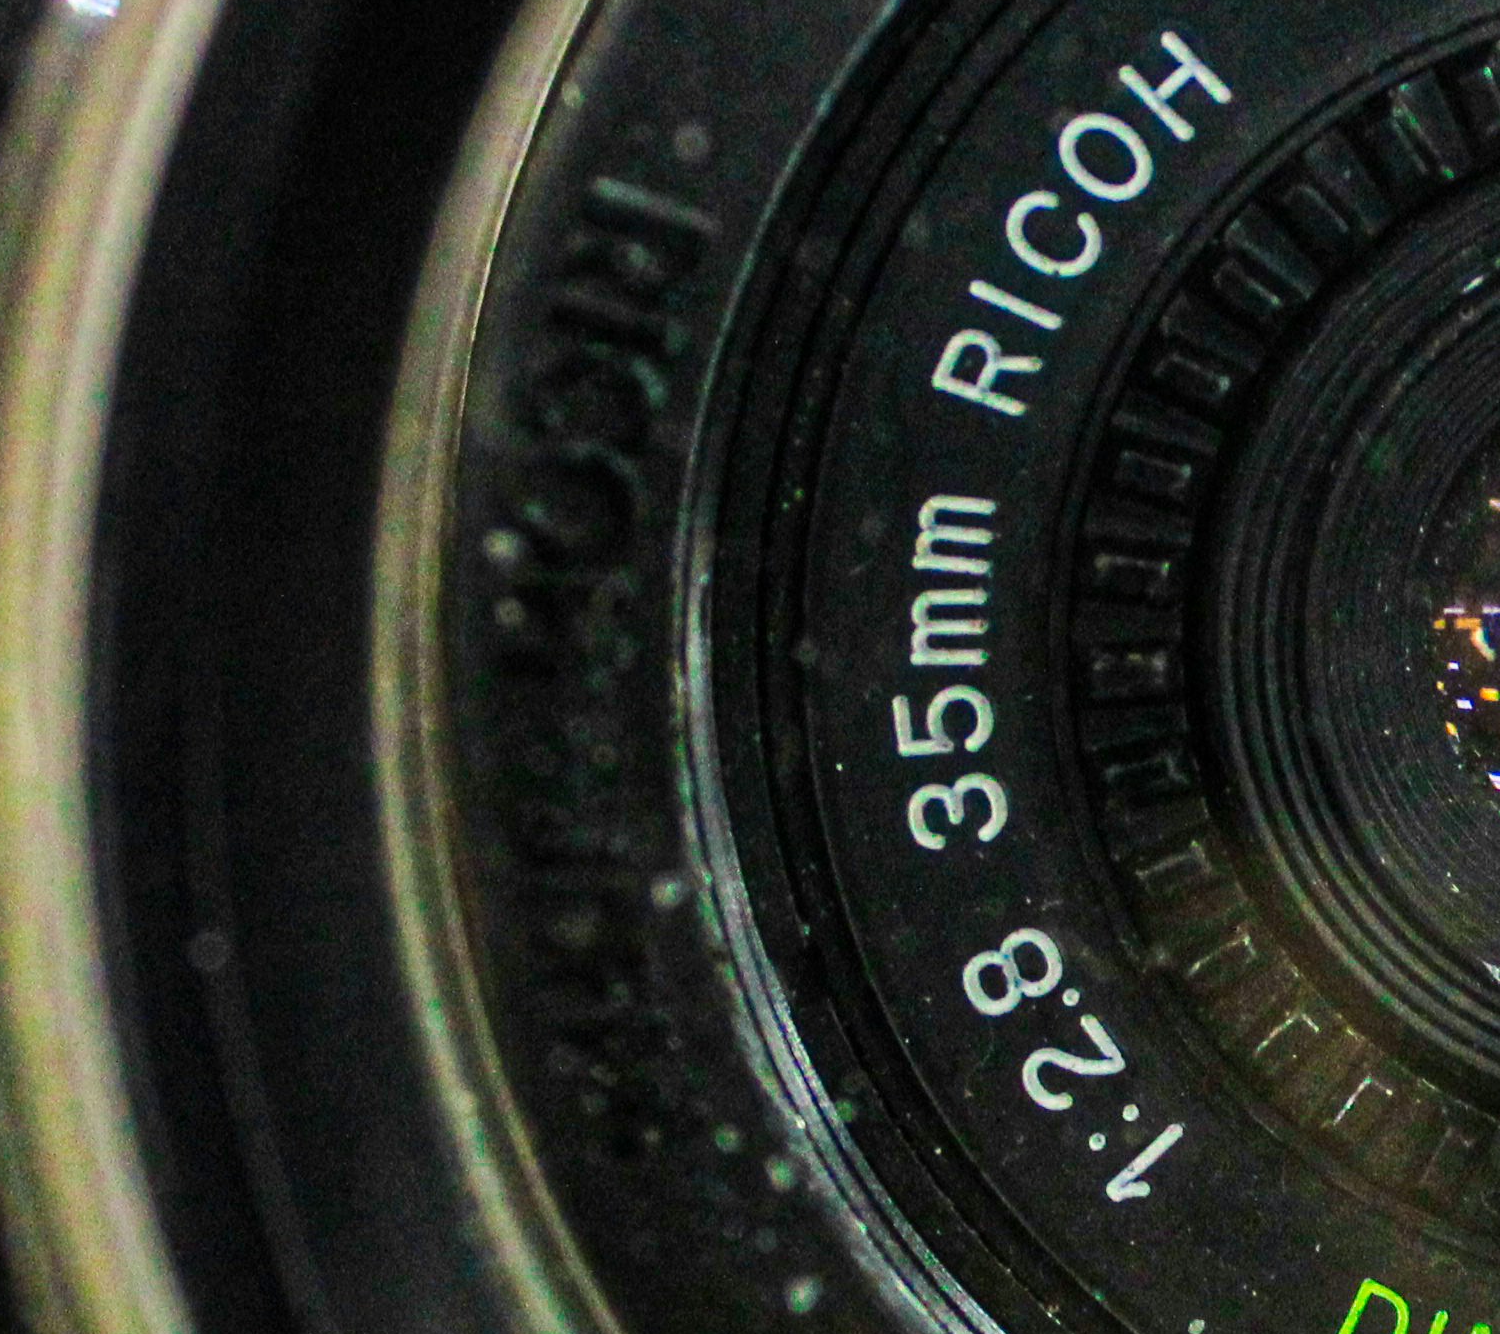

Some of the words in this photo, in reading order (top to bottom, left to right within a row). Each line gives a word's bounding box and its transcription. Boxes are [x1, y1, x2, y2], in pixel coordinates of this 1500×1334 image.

[932, 32, 1231, 416] RICOH
[892, 496, 1007, 850] 35mm
[962, 928, 1185, 1203] 1:2.8
